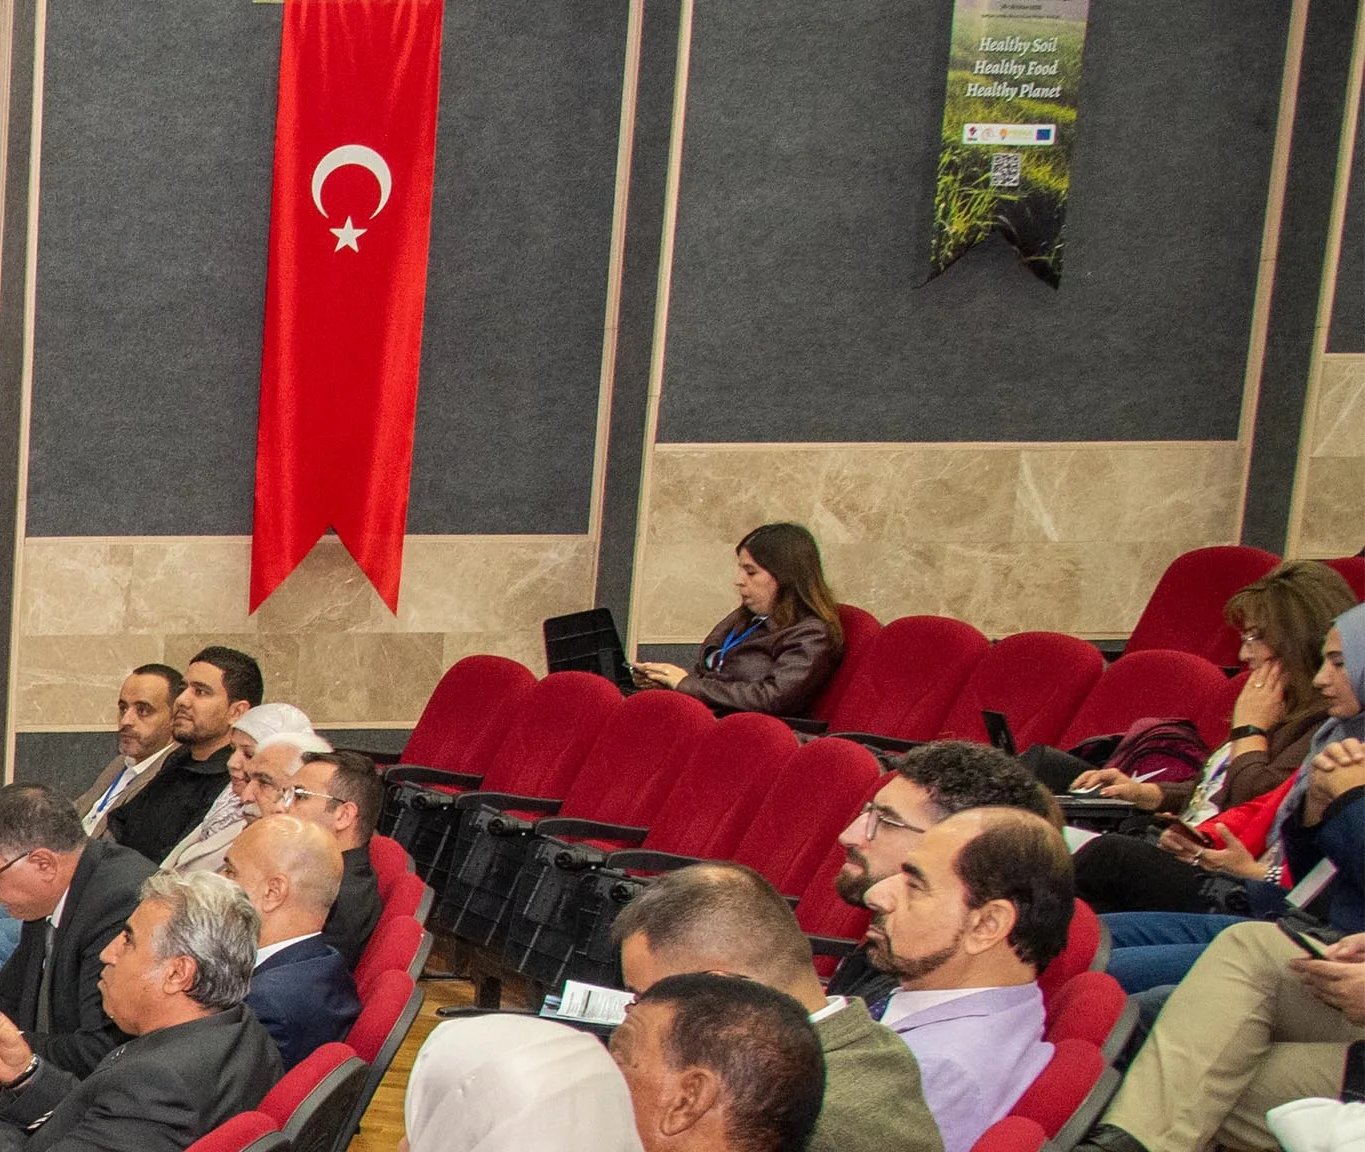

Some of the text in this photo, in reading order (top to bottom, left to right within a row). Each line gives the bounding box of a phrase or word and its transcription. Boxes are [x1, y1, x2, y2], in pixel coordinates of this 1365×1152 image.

[979, 36, 1058, 57] Healthy Soil
[973, 59, 1060, 80] Healthy Food
[965, 81, 1062, 102] Healthy Planet
